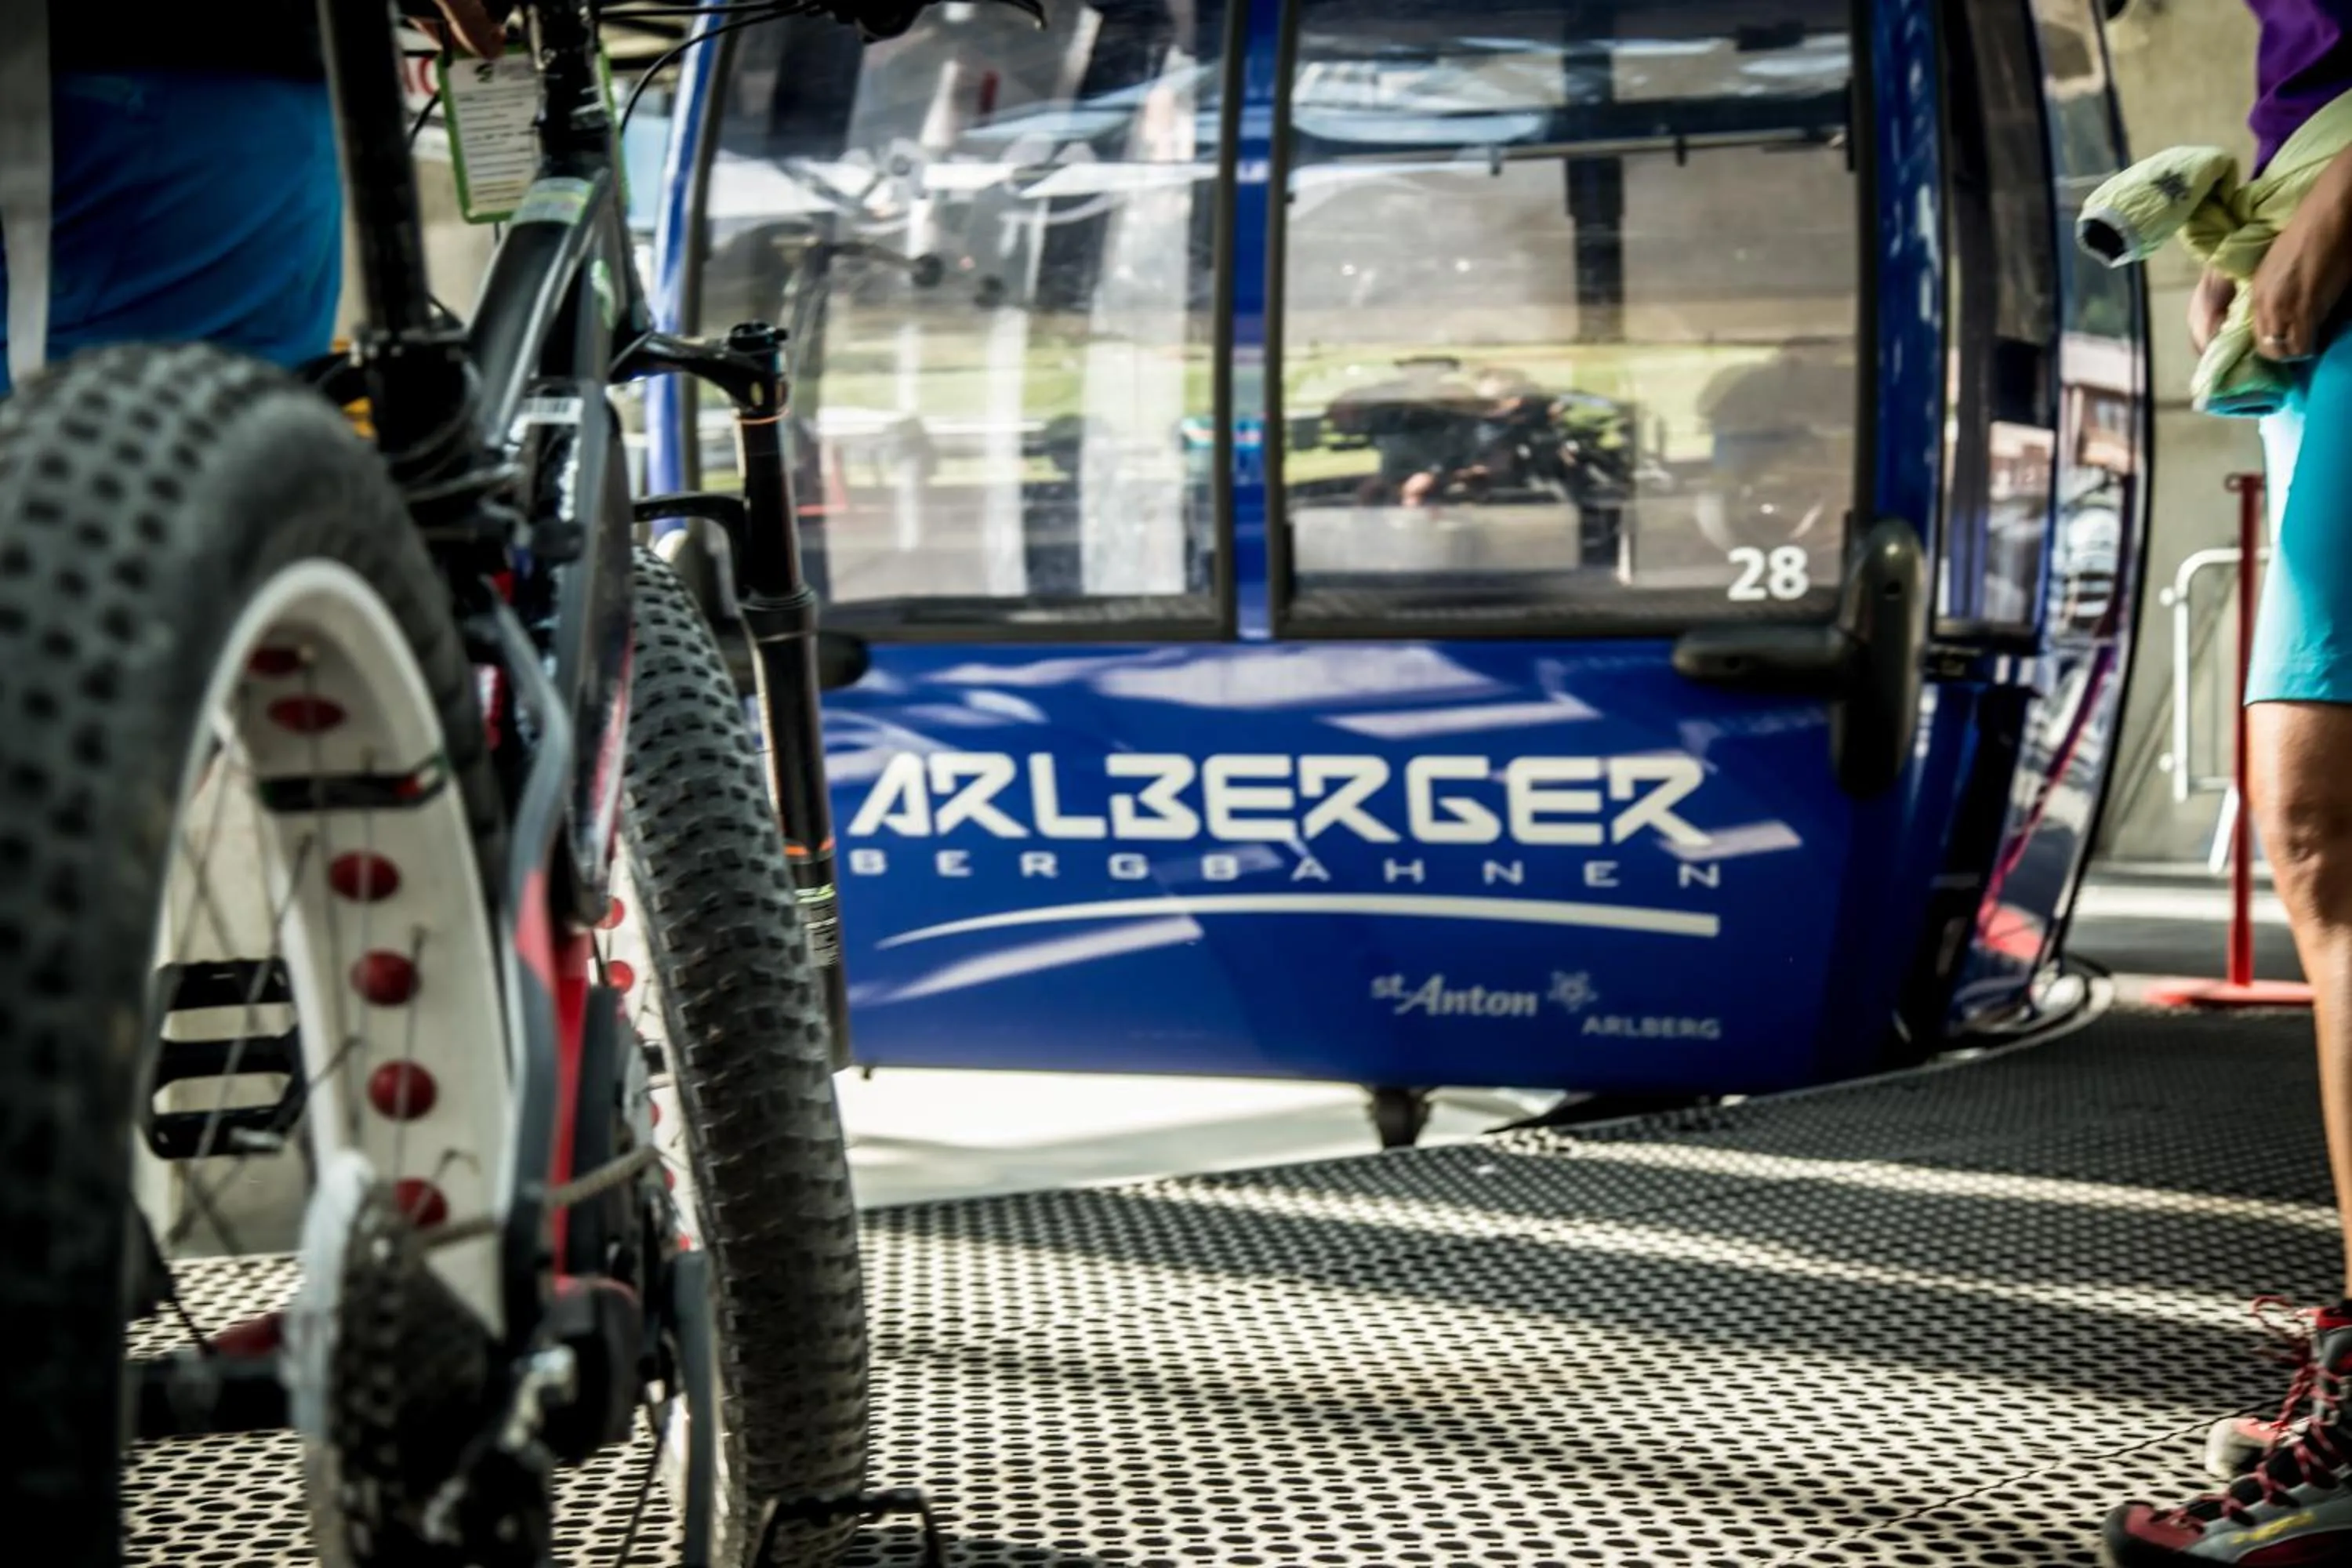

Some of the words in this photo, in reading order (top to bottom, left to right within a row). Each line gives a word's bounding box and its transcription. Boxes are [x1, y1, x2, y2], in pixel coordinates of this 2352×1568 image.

[1727, 546, 1809, 601] 28
[848, 753, 1712, 846] ARLBERGER
[849, 848, 1719, 888] BERGBAHNEN
[1393, 973, 1539, 1016] Anton
[1581, 1015, 1722, 1040] ARLBERG
